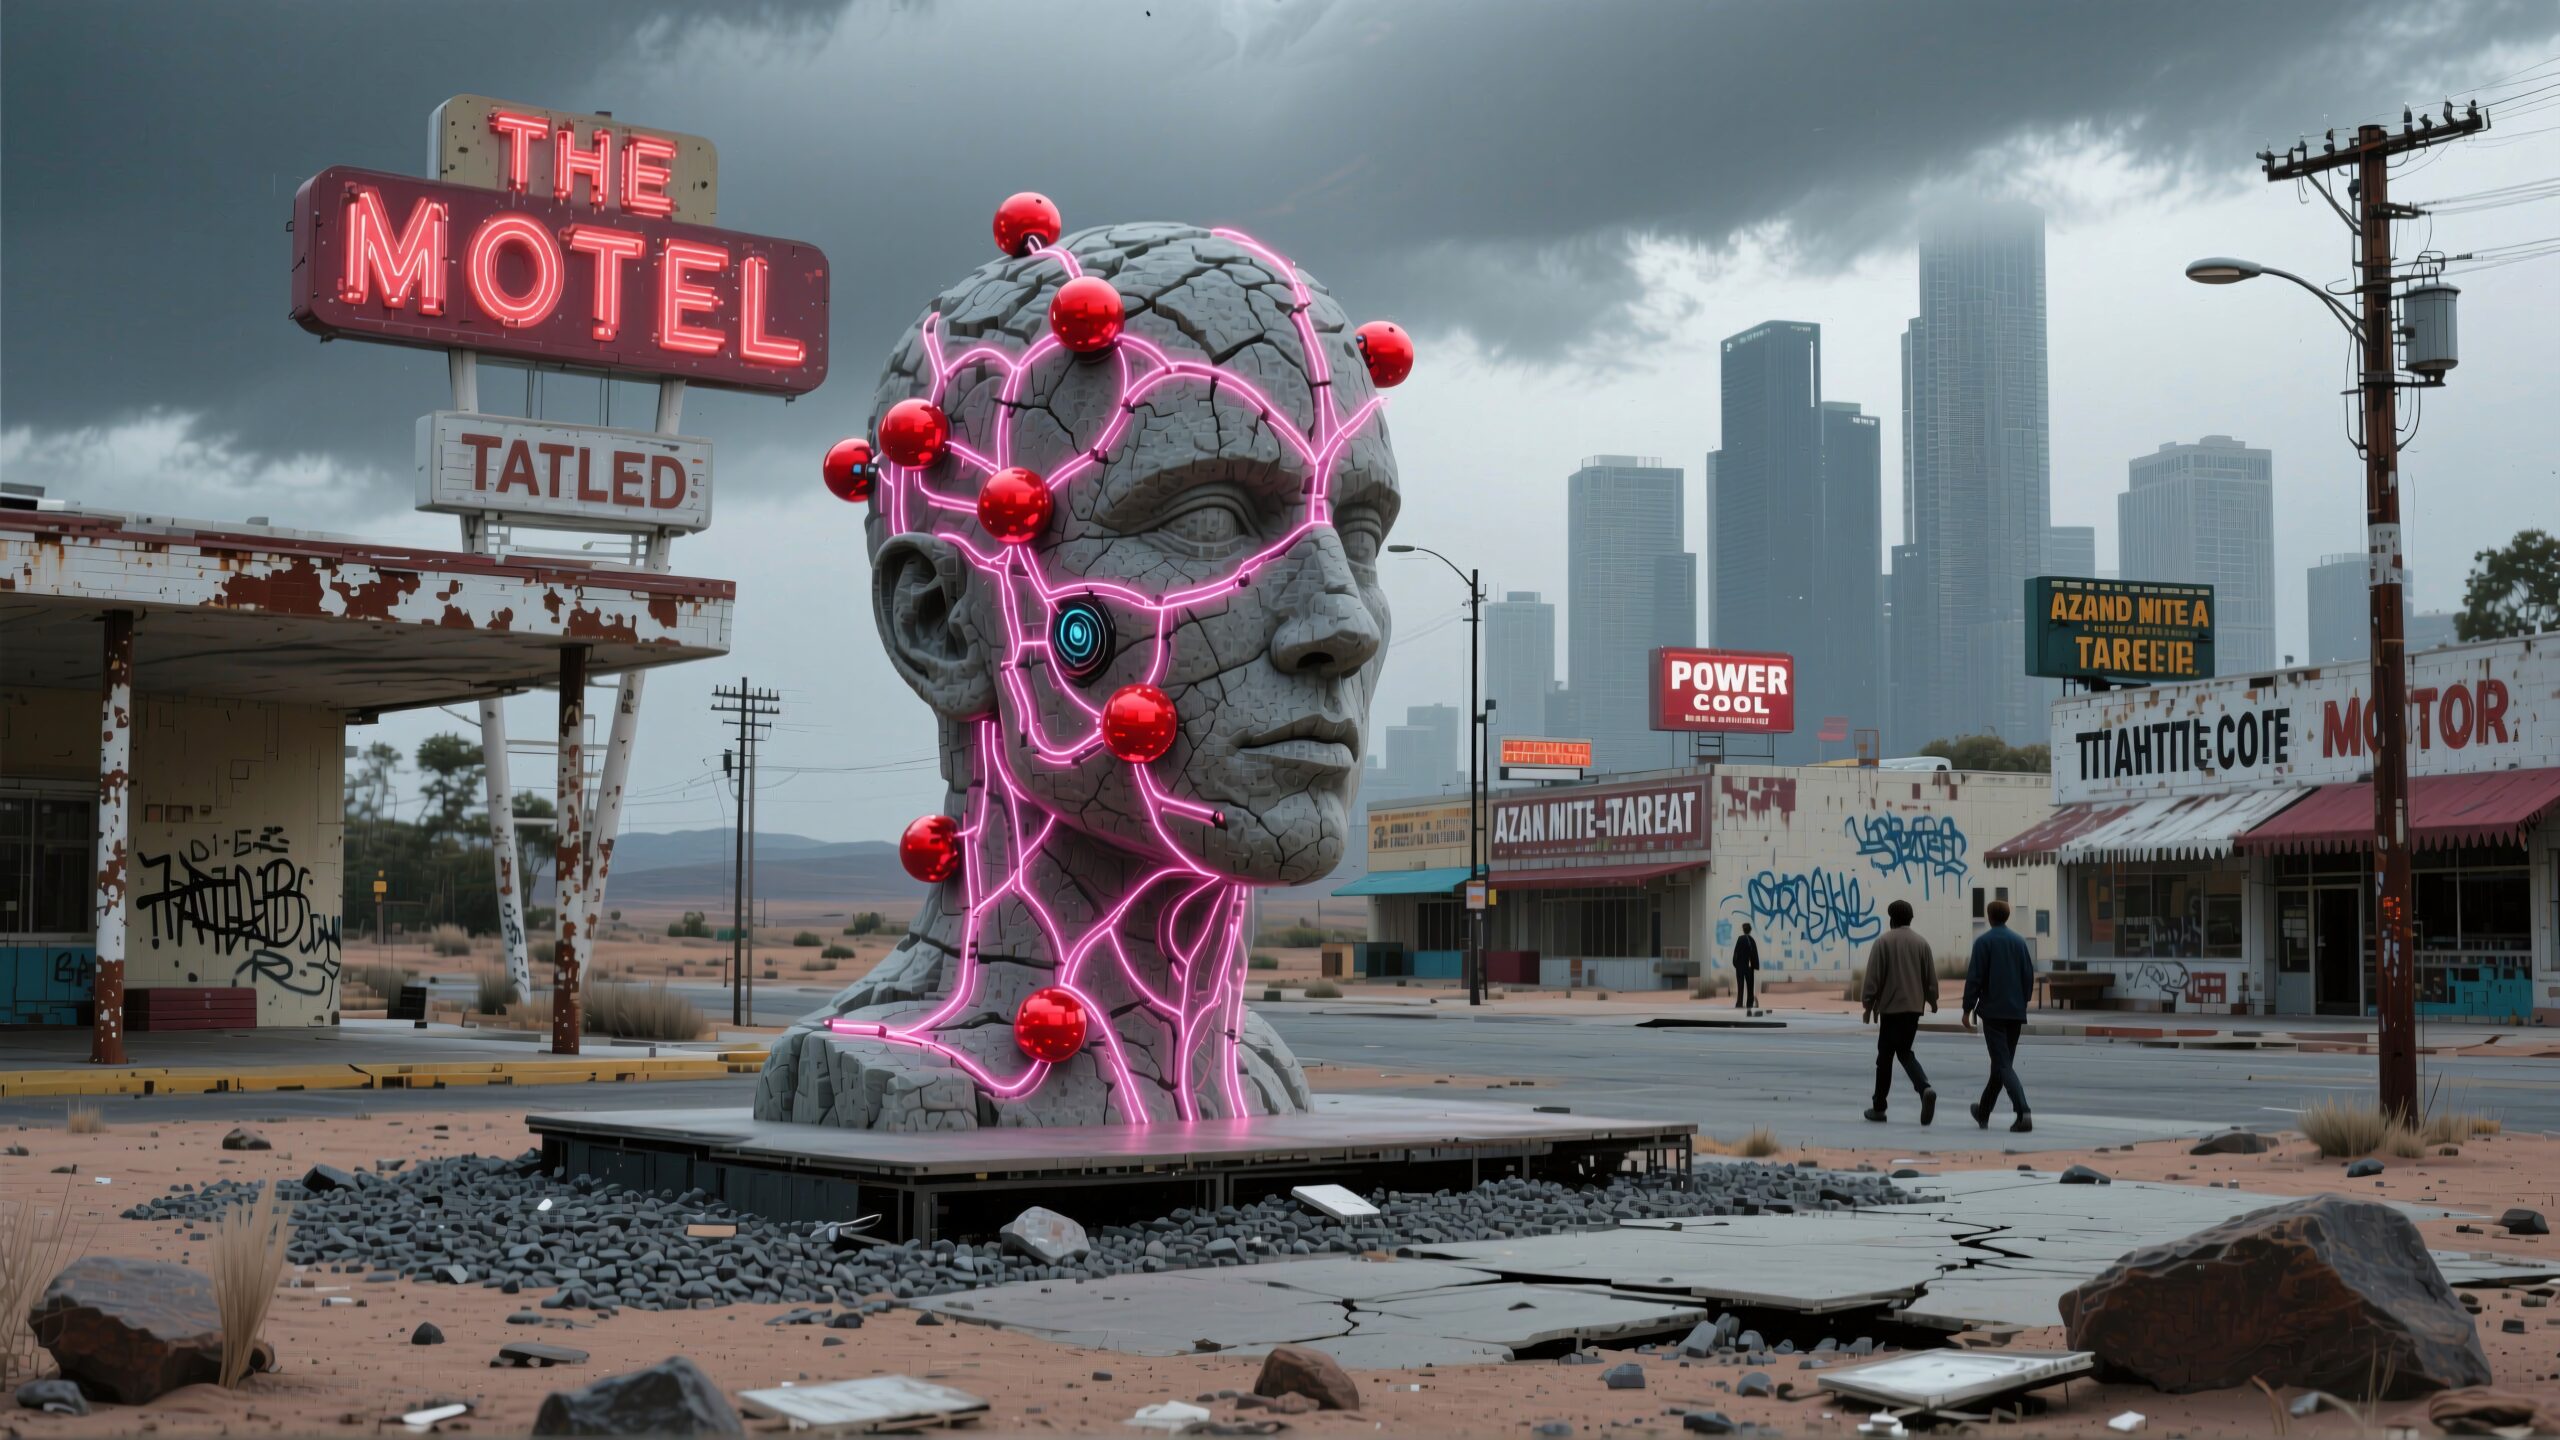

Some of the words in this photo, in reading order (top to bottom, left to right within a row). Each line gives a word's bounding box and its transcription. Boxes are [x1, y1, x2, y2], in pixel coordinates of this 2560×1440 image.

[488, 109, 678, 218] THE
[340, 184, 806, 367] MOTEL
[461, 432, 687, 510] TATLED
[2051, 592, 2132, 622] AZAND
[1671, 660, 1788, 695] POWER
[1693, 693, 1770, 714] COOL
[1494, 803, 1545, 844] AZAN
